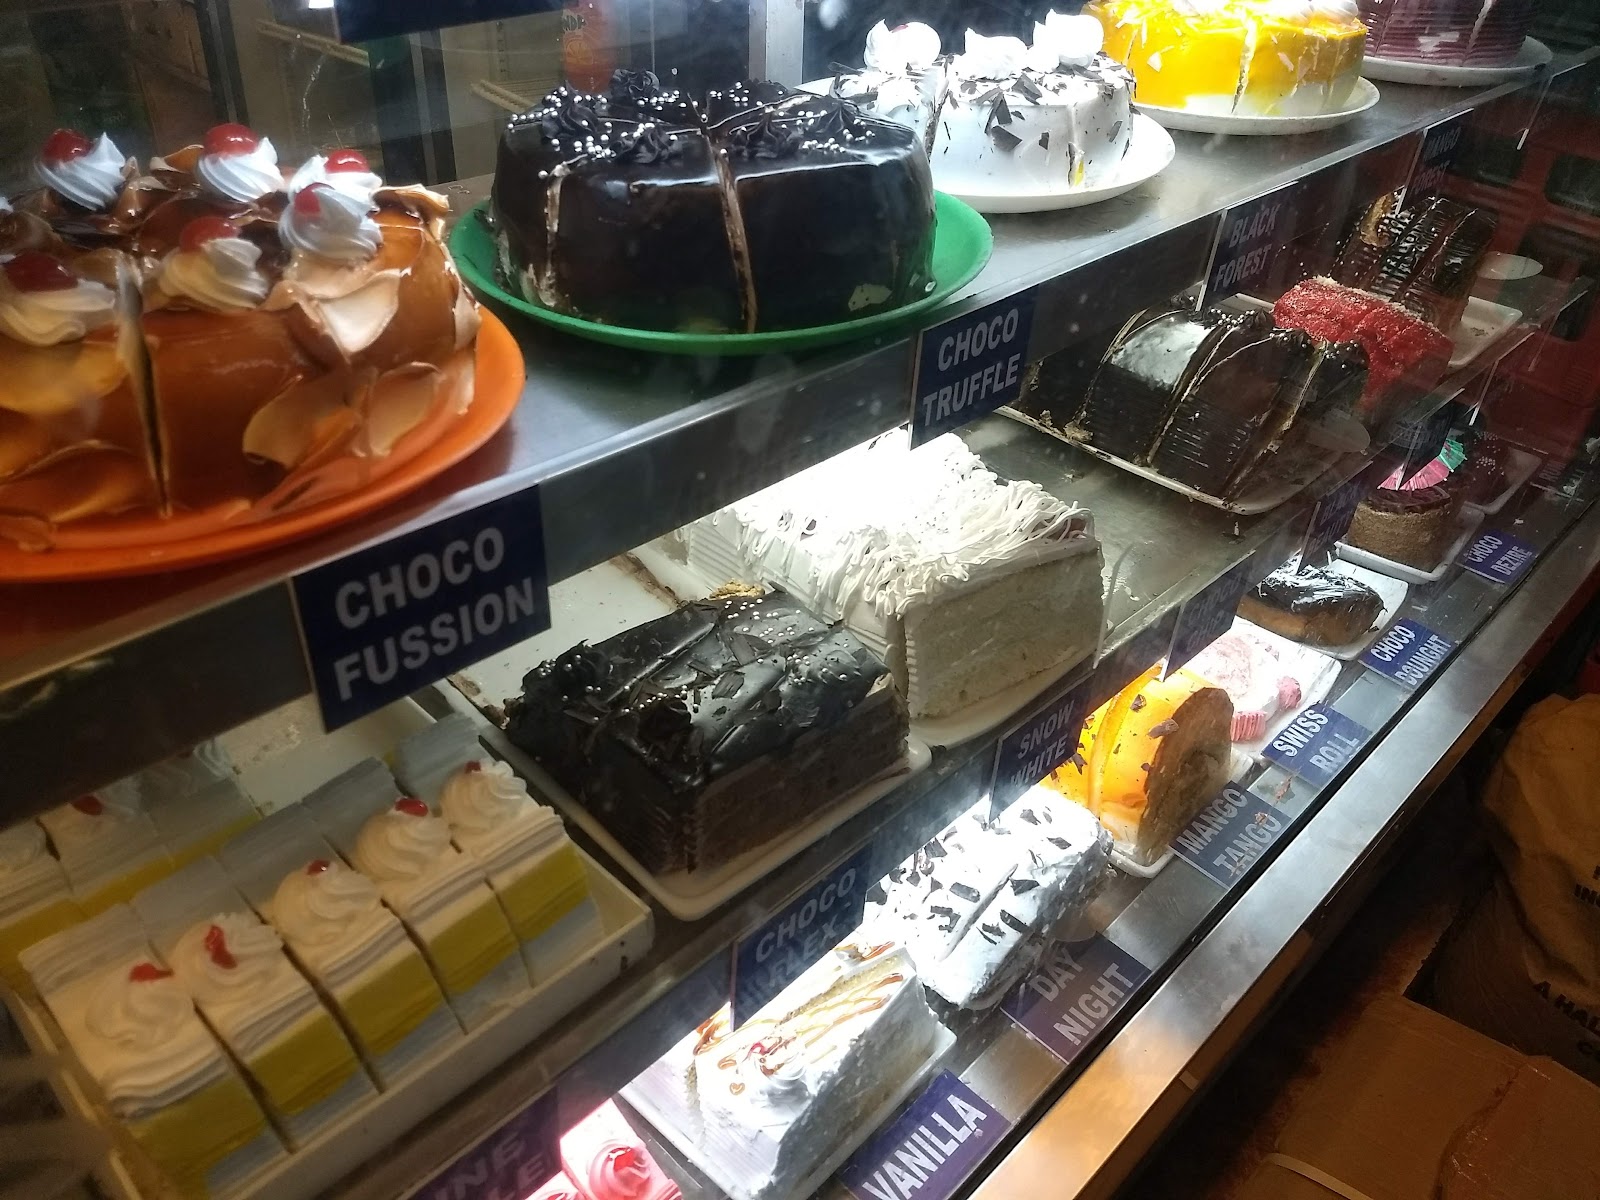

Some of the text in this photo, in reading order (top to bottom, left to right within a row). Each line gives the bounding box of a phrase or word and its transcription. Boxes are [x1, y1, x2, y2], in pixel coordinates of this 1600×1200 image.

[1229, 204, 1280, 248] BLACK
[1213, 244, 1272, 292] FOREST
[938, 308, 1019, 372] CHOCO
[923, 353, 1021, 426] TRUFFLE
[1468, 535, 1503, 563] CHOCO
[1490, 546, 1533, 576] DEZIRE
[335, 528, 505, 629] CHOCO
[333, 577, 535, 702] FUSSION
[1370, 625, 1416, 662] CHOCO
[1394, 634, 1452, 686] DOUNGHT
[1018, 700, 1075, 759] SNOW
[1272, 709, 1329, 757] SWISS
[1309, 733, 1360, 774] ROLL
[1011, 733, 1068, 787] WHITE
[1176, 788, 1249, 855] MANGO
[1213, 812, 1282, 875] TANGO
[756, 868, 856, 963] CHOCO
[1028, 946, 1083, 1002] DAY
[1053, 962, 1134, 1046] NIGHT
[861, 1094, 987, 1200] VANILLA
